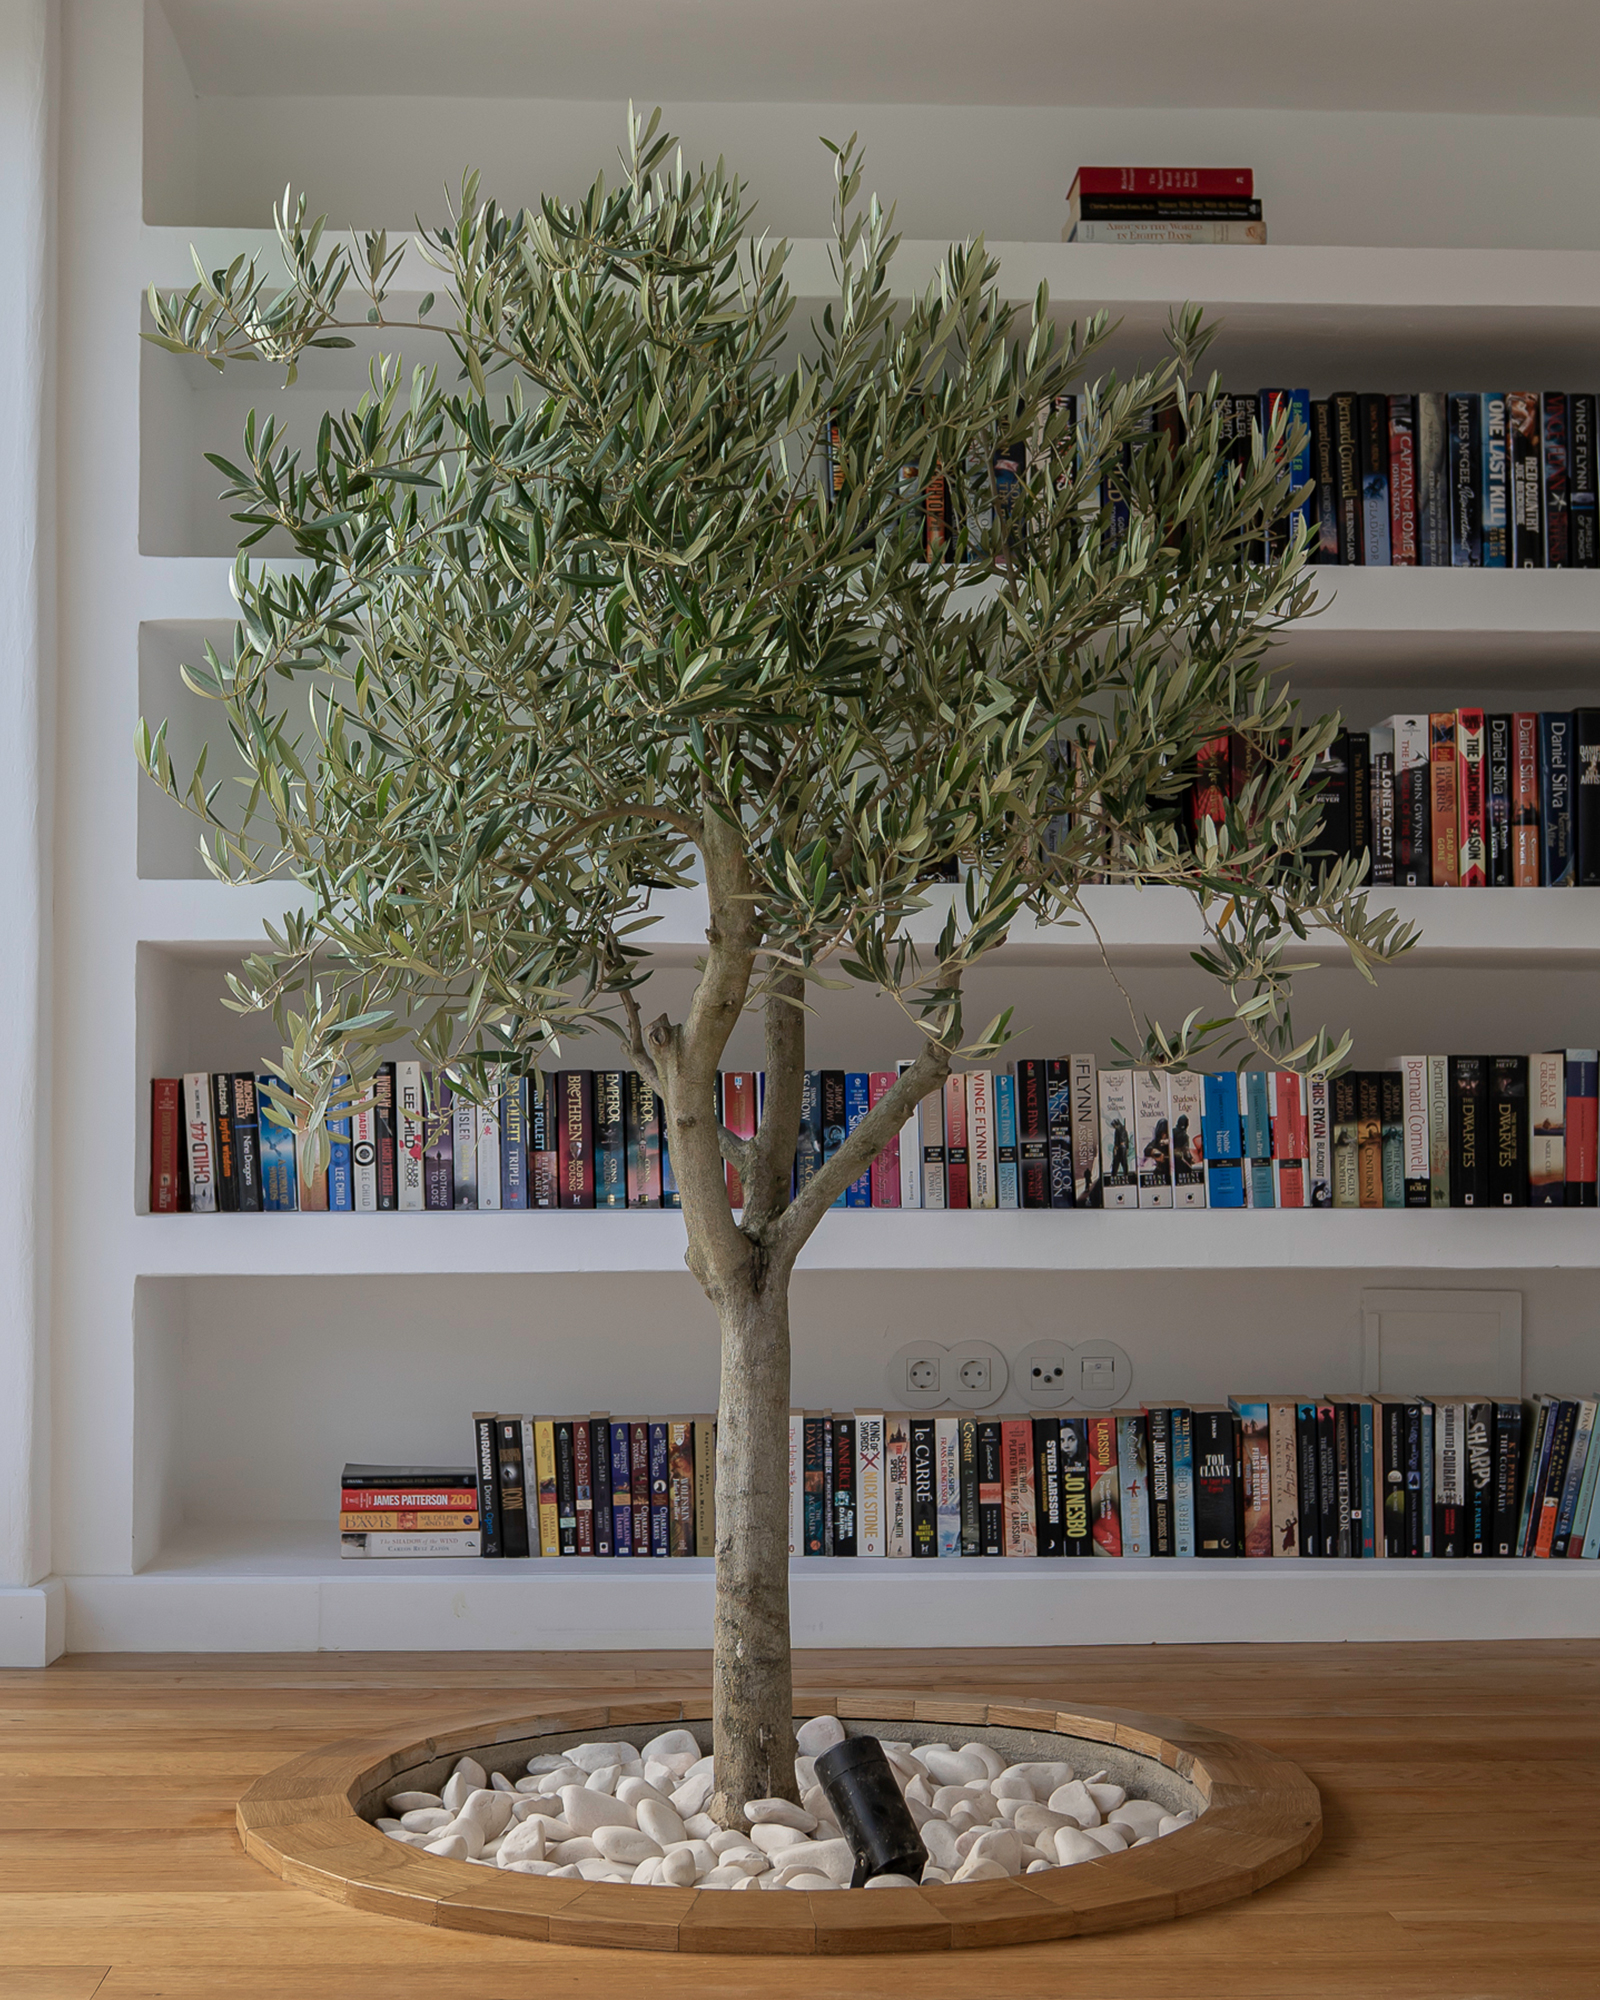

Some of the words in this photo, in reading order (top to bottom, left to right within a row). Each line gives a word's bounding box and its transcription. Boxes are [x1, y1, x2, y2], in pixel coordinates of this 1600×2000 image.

[1106, 223, 1147, 231] AROUND
[1130, 231, 1165, 240] EIGHTY
[1168, 231, 1192, 239] DAYS
[1337, 397, 1355, 443] Bernard
[1456, 399, 1469, 440] JAMES
[1489, 400, 1504, 436] ONE
[1575, 399, 1587, 442] VINCE
[1338, 444, 1357, 498] Cornwell
[1392, 463, 1400, 488] JOHN
[1400, 436, 1413, 498] CAPTAIN
[1489, 440, 1505, 482] LAST
[1525, 456, 1538, 481] RED
[1576, 446, 1587, 490] FLYNN
[1393, 491, 1401, 521] STACK
[1490, 486, 1506, 524] KILL
[1526, 482, 1539, 533] COUNTRY
[1577, 515, 1584, 526] OF
[1346, 513, 1355, 542] BURNING
[1369, 501, 1379, 561] GLADIATOR
[1402, 511, 1414, 552] ROME
[1489, 527, 1498, 557] EISLER
[1347, 543, 1355, 561] LAND
[1466, 738, 1480, 758] THE
[1491, 720, 1506, 761] Daniel
[1519, 718, 1533, 760] Daniel
[1551, 722, 1566, 768] Daniel
[1413, 770, 1423, 800] JOHN
[1435, 766, 1446, 812] HARRIS
[1467, 761, 1481, 816] MARCHING
[1493, 765, 1507, 794] Silva
[1520, 764, 1534, 793] Silva
[1552, 774, 1568, 809] Silva
[1382, 770, 1391, 827] LONELY
[1382, 830, 1392, 859] CITY
[1414, 803, 1423, 854] GWYNNE
[1446, 828, 1454, 851] DEAD
[1468, 820, 1481, 860] SEASON
[1437, 838, 1446, 861] GONE
[1447, 853, 1455, 871] AND
[597, 1074, 605, 1096] DEATH
[1407, 1061, 1424, 1112] Bernard
[1540, 1062, 1548, 1108] CRUSADE
[1548, 1062, 1557, 1081] THE
[217, 1075, 229, 1115] nietzsche
[234, 1079, 246, 1119] CONNELLY
[244, 1080, 254, 1117] MICHAEL
[404, 1087, 415, 1109] LEE
[606, 1074, 620, 1125] EMPEROR
[973, 1074, 986, 1114] VINCE
[1076, 1064, 1092, 1122] FLYNN
[1549, 1085, 1557, 1109] LAST
[190, 1121, 207, 1141] 44
[218, 1118, 230, 1142] joyful
[458, 1107, 472, 1140] EISLER
[507, 1098, 520, 1143] FOLLETT
[534, 1112, 545, 1150] FOLLETT
[1314, 1108, 1326, 1139] RYAN
[1463, 1104, 1475, 1167] DWARVES
[1499, 1104, 1511, 1167] DWARVES
[242, 1135, 252, 1153] Nine
[975, 1118, 987, 1160] FLYNN
[1078, 1124, 1088, 1166] ASSASSIN
[1087, 1129, 1095, 1161] AMERICAN
[1216, 1131, 1224, 1154] House
[1409, 1115, 1427, 1171] Cornwell
[192, 1143, 210, 1184] CHILD
[222, 1145, 231, 1177] wisdom
[243, 1155, 253, 1185] Dragons
[334, 1167, 344, 1181] LEE
[361, 1168, 371, 1181] LEE
[509, 1149, 519, 1186] TRIPLE
[568, 1160, 576, 1191] YOUNG
[1051, 1144, 1063, 1197] TREASON
[1062, 1149, 1070, 1173] ACT
[1316, 1142, 1325, 1177] BLACKOUT
[1365, 1148, 1374, 1198] CENTURION
[268, 1166, 279, 1201] SWORDS
[278, 1166, 287, 1192] STORM
[431, 1171, 438, 1182] TO
[439, 1169, 447, 1207] NOTHING
[1063, 1177, 1072, 1193] OF
[280, 1194, 288, 1204] OF
[335, 1182, 346, 1205] CHILD
[362, 1183, 372, 1207] CHILD
[431, 1184, 439, 1205] LOSE
[870, 1421, 880, 1441] KING
[915, 1428, 930, 1441] le
[1445, 1408, 1455, 1448] UNDAUNTED
[1581, 1407, 1592, 1430] IVAN
[838, 1437, 851, 1466] ANNE
[860, 1421, 869, 1452] SWORDS
[870, 1442, 879, 1452] OF
[963, 1422, 975, 1463] Corsair
[1097, 1422, 1110, 1466] LARSSON
[1153, 1440, 1166, 1462] JAMES
[1575, 1433, 1586, 1458] DOIG
[890, 1459, 898, 1482] SPEECH
[898, 1455, 907, 1485] SECRET
[1046, 1440, 1057, 1472] STIEG
[1443, 1450, 1456, 1491] COURAGE
[1468, 1422, 1491, 1489] SHARPS
[839, 1467, 852, 1488] RICE
[864, 1471, 878, 1498] NICK
[1065, 1474, 1085, 1490] JO
[1154, 1464, 1168, 1500] PATTERSON
[1339, 1468, 1348, 1494] THE
[373, 1495, 400, 1506] JAMES
[401, 1495, 448, 1505] PATTERSON
[451, 1495, 472, 1505] ZOO
[484, 1485, 493, 1510] Doors
[502, 1487, 523, 1510] ICON
[1048, 1474, 1059, 1524] LARSSON
[1339, 1496, 1349, 1531] DOOR
[485, 1513, 495, 1534] Open
[641, 1506, 649, 1545] CHARLAINE
[864, 1502, 878, 1538] STONE
[1012, 1512, 1020, 1544] LARSSON
[1020, 1511, 1028, 1532] STIEG
